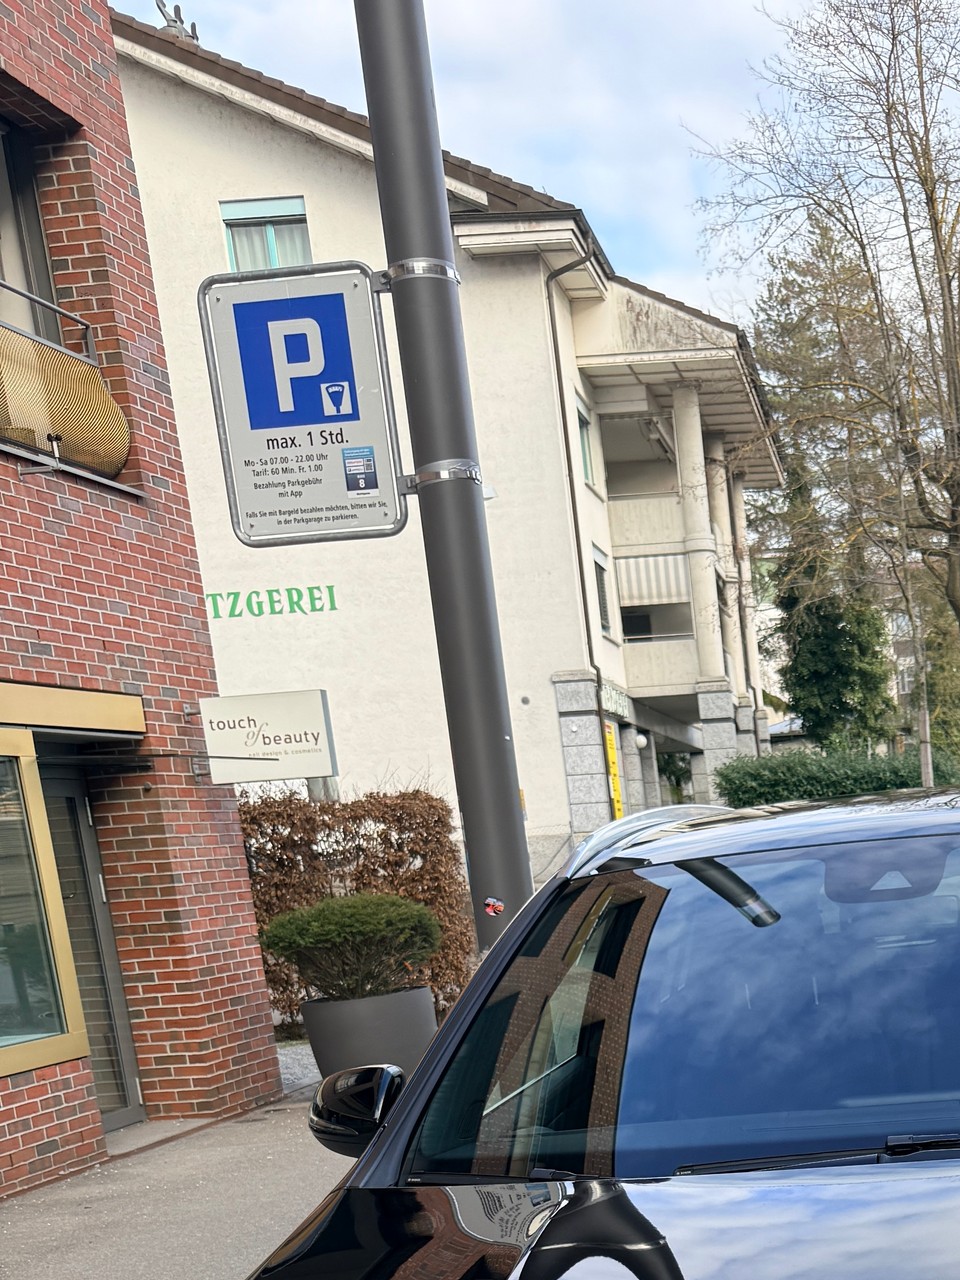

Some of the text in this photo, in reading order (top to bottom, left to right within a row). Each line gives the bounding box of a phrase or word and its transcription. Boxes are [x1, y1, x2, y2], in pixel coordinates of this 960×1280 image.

[267, 317, 326, 413] P
[266, 427, 349, 450] max. 1 Std.
[269, 456, 289, 465] 07.00
[295, 454, 315, 463] 22.00
[316, 452, 329, 461] Uhr
[252, 464, 323, 477] Tarif: 60 Min. Fr. 1.00
[253, 477, 323, 490] Bezahlung Parkgebühr
[359, 479, 366, 488] 8
[278, 490, 303, 499] mit App
[278, 508, 299, 517] Bargeld
[300, 506, 324, 514] bezahlen
[325, 504, 350, 512] möchten,
[293, 516, 324, 525] Parkgarage
[332, 513, 359, 522] parkieren.
[205, 584, 339, 619] TZGEREI
[209, 716, 257, 731] touch
[244, 722, 269, 747] of
[262, 730, 320, 746] beauty
